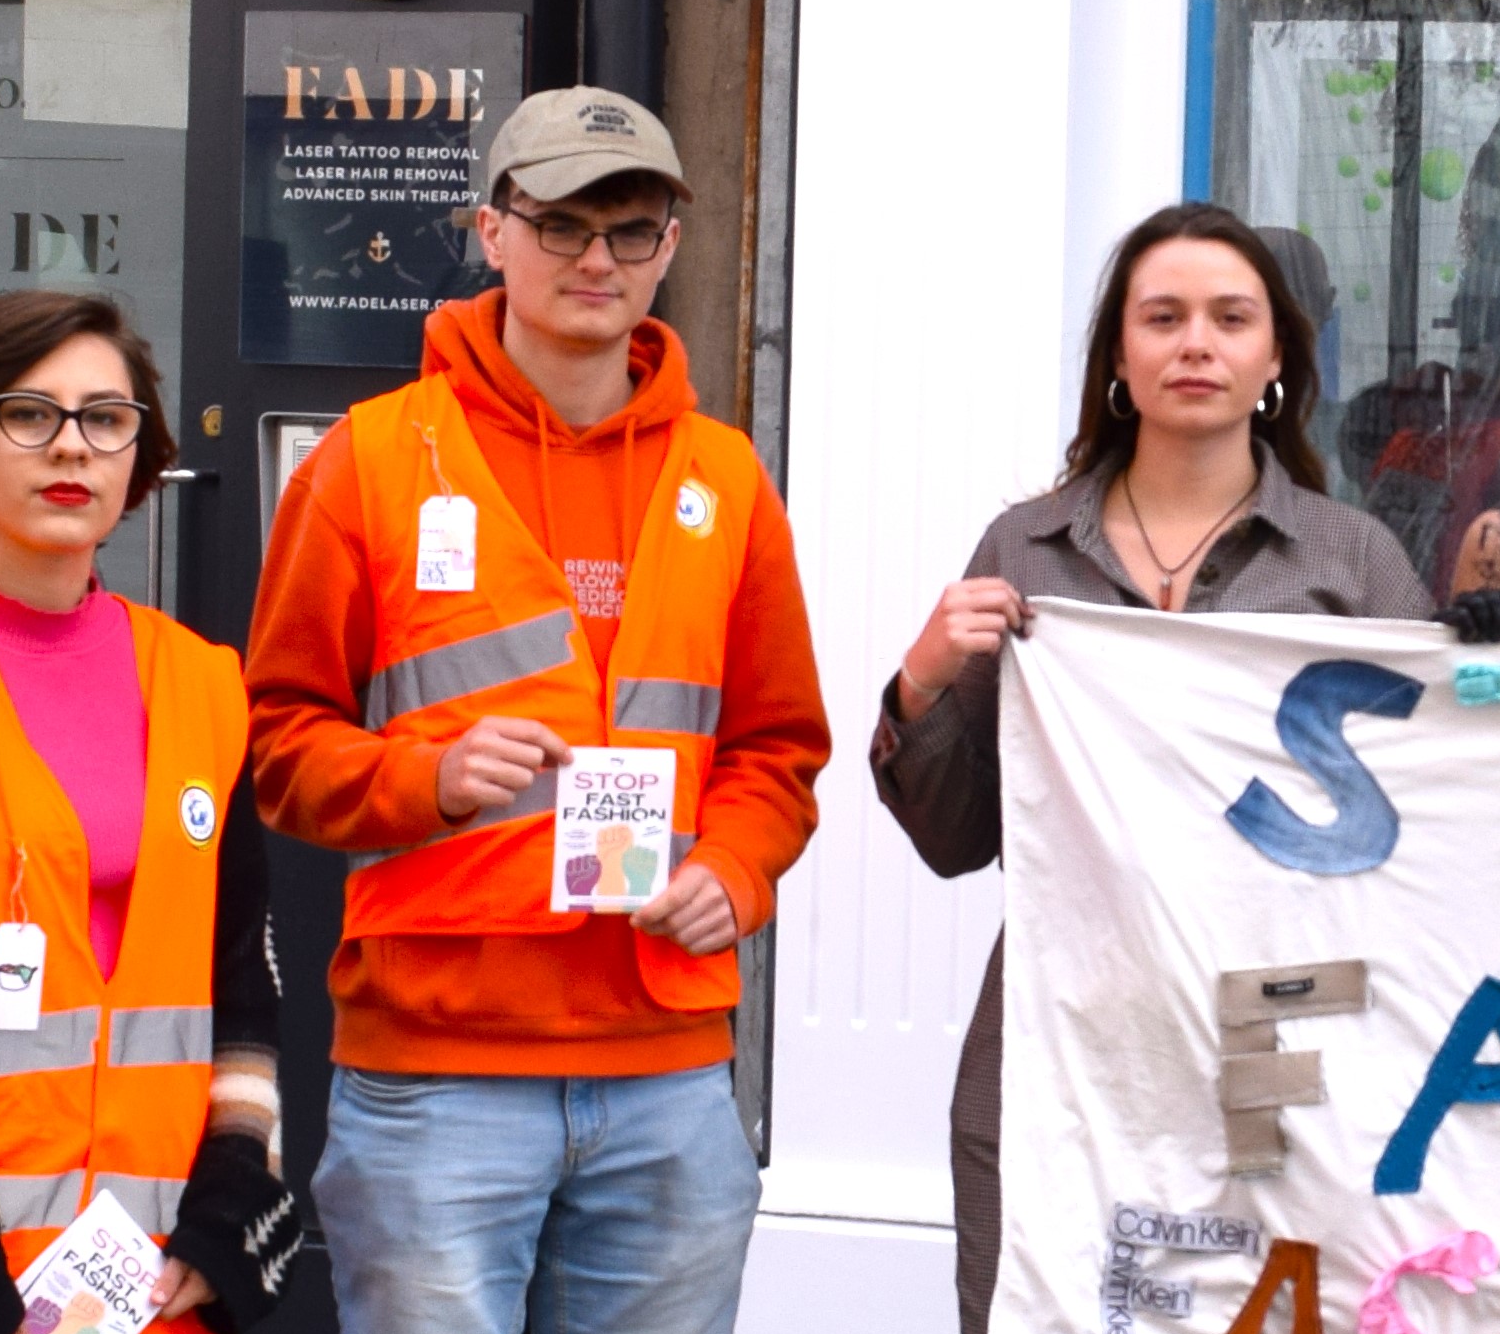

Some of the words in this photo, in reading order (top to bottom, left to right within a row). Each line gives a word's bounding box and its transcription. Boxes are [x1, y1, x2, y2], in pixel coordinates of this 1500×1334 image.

[283, 66, 484, 122] FADE
[285, 145, 334, 158] LASER
[339, 146, 400, 159] TATTOO
[406, 147, 481, 161] REMOVAL
[296, 167, 345, 179] LASER
[350, 168, 388, 180] HAIR
[394, 168, 469, 181] REMOVAL
[283, 188, 365, 201] ADVANCED
[370, 189, 405, 202] SKIN
[410, 189, 481, 204] THERAPY
[574, 772, 659, 790] STOP
[586, 792, 646, 806] FAST
[563, 806, 667, 822] FASHION
[1115, 1208, 1196, 1245] Calvin
[1199, 1216, 1260, 1257] Klein
[92, 1228, 157, 1289] STOP
[62, 1249, 143, 1325] FASHION
[89, 1252, 138, 1298] FAST
[1131, 1278, 1191, 1310] Klein
